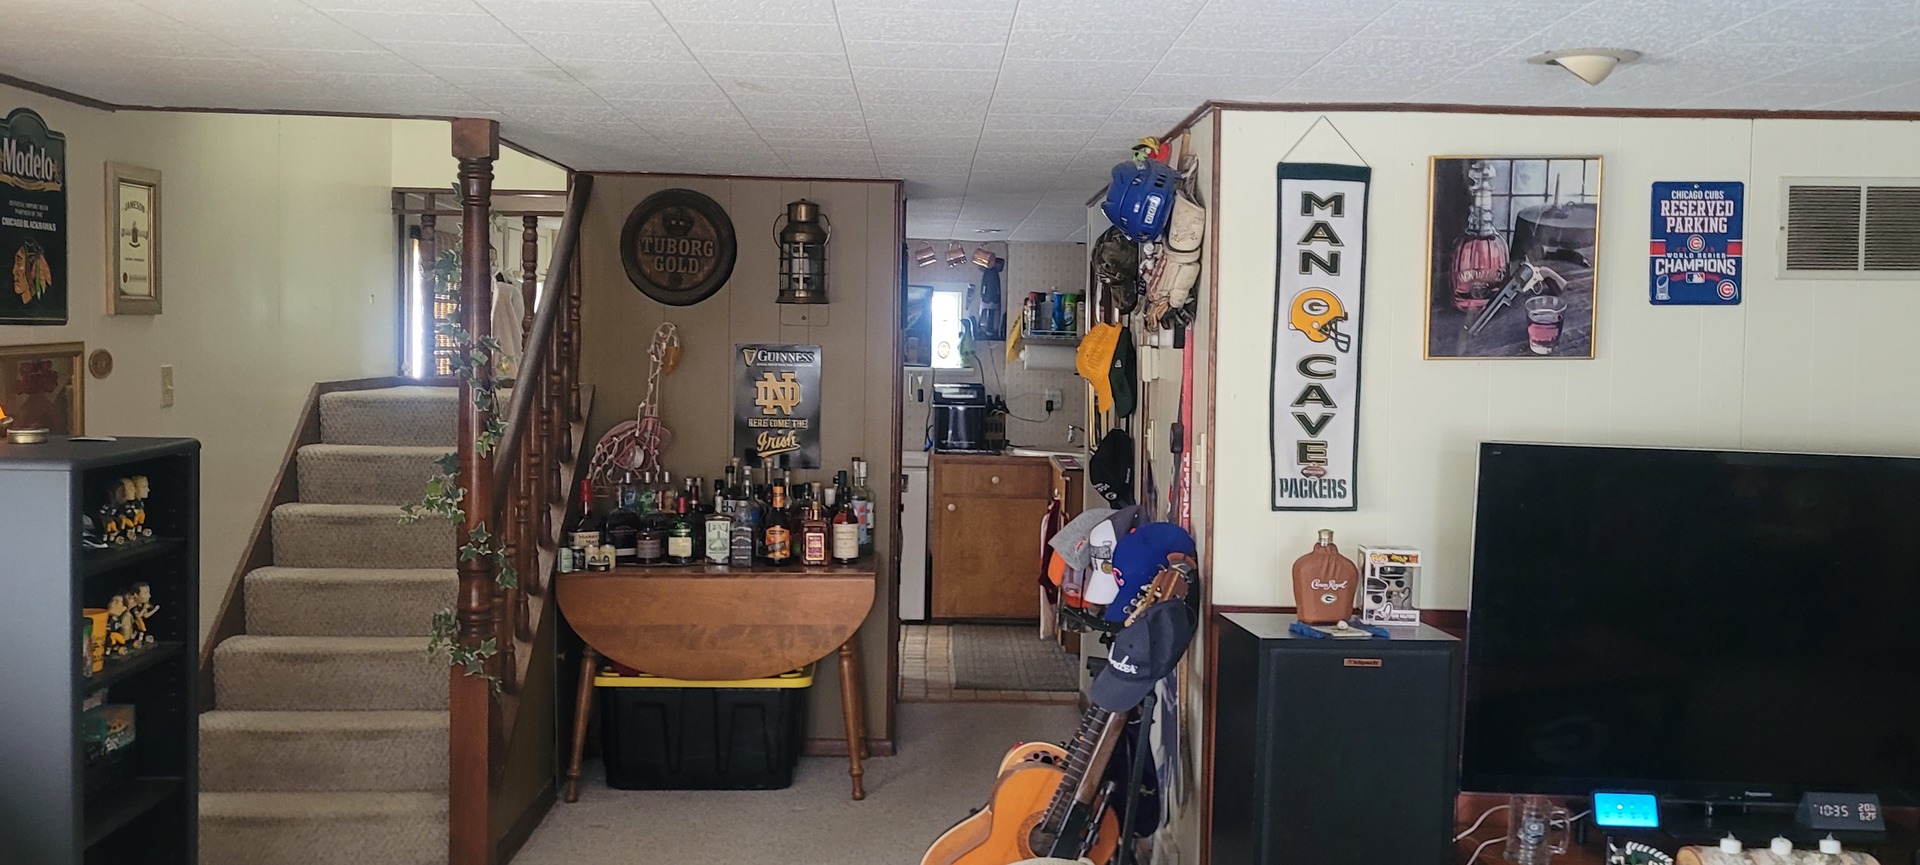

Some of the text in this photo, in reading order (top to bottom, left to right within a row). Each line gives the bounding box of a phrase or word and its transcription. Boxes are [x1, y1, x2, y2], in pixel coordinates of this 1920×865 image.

[3, 137, 53, 181] Modelo
[1671, 190, 1725, 200] CHICAGO CUBS
[1660, 200, 1735, 217] RESERVED
[1, 216, 24, 228] CHICAGO
[1666, 217, 1728, 233] PARKING
[1297, 190, 1345, 277] MAN
[641, 236, 714, 257] TUBORG
[654, 255, 699, 274] GOLD
[1655, 259, 1736, 276] CHAMPIONS
[757, 349, 815, 364] GUINNESS
[1290, 353, 1338, 466] CAVE
[748, 418, 809, 429] HERE COME THE
[757, 430, 800, 457] Irish
[1182, 451, 1190, 518] TITAN
[1279, 477, 1347, 499] PACKERS
[1819, 804, 1849, 818] 10:35
